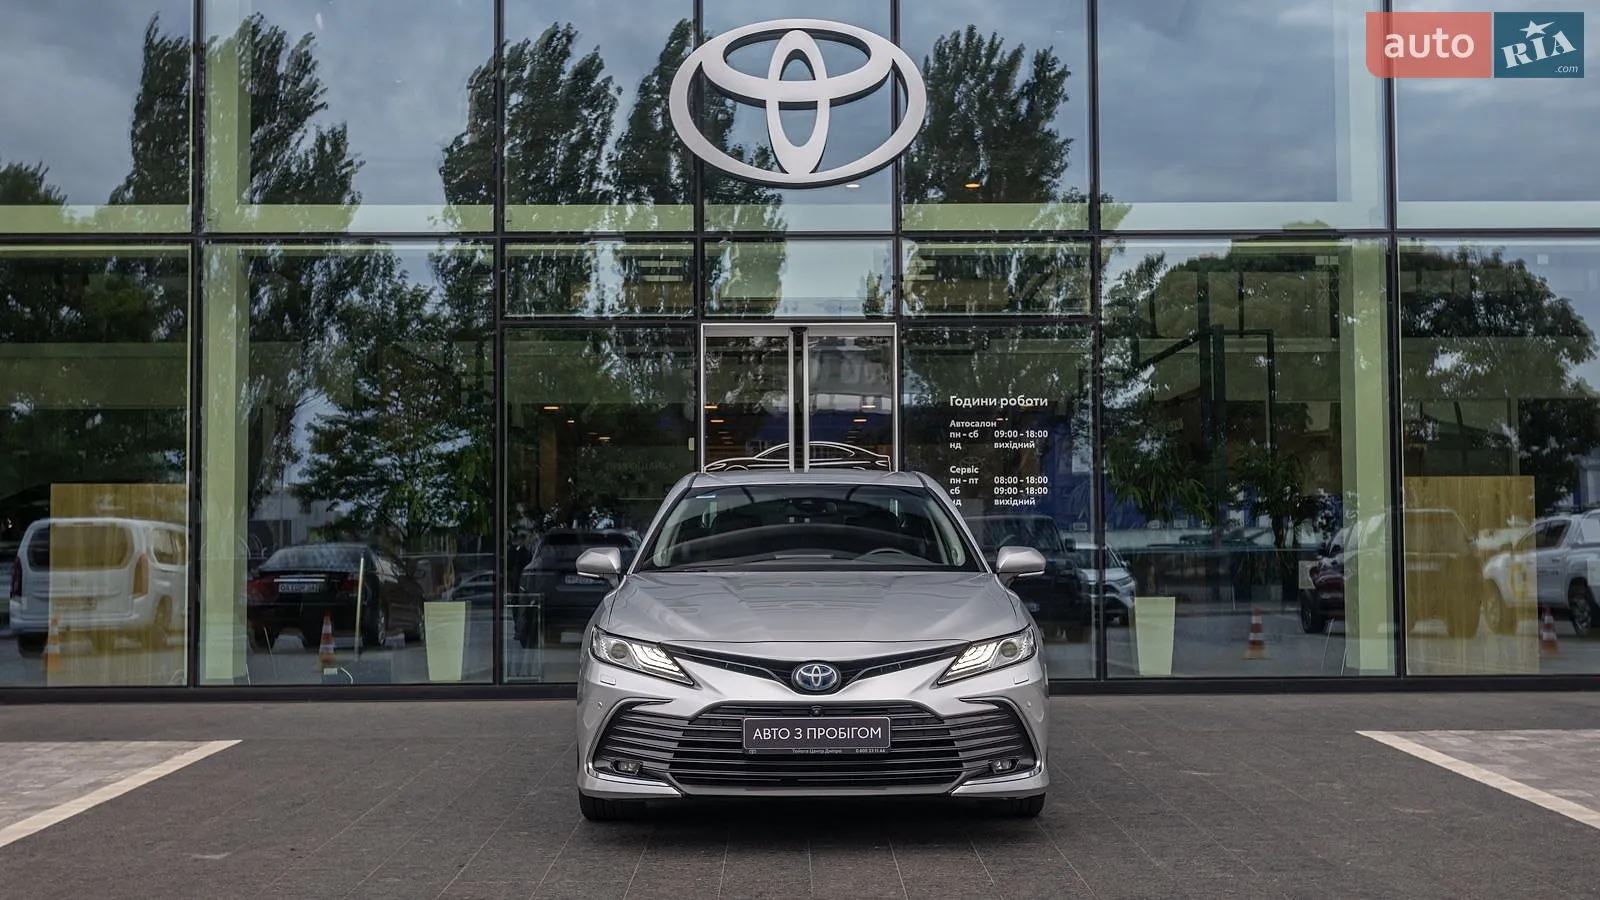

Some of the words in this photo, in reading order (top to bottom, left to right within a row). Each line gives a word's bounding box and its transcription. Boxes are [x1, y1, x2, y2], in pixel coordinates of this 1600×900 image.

[949, 395, 997, 408] Години
[1000, 394, 1048, 409] роботи
[949, 420, 997, 428] Автосалон
[968, 430, 979, 438] сб
[994, 430, 1018, 438] 09:00
[1025, 430, 1048, 438] 18:00
[949, 442, 962, 450] нд
[994, 440, 1035, 450] вихідний
[949, 465, 979, 475] Сервіс
[994, 476, 1018, 484] 08:00
[1025, 476, 1048, 484] 18:00
[949, 486, 960, 494] сб
[994, 487, 1018, 495] 09:00
[1025, 487, 1048, 495] 18:00
[994, 497, 1036, 507] вихідний
[753, 727, 791, 740] АВТО
[807, 727, 882, 740] ПРОБІГОМ
